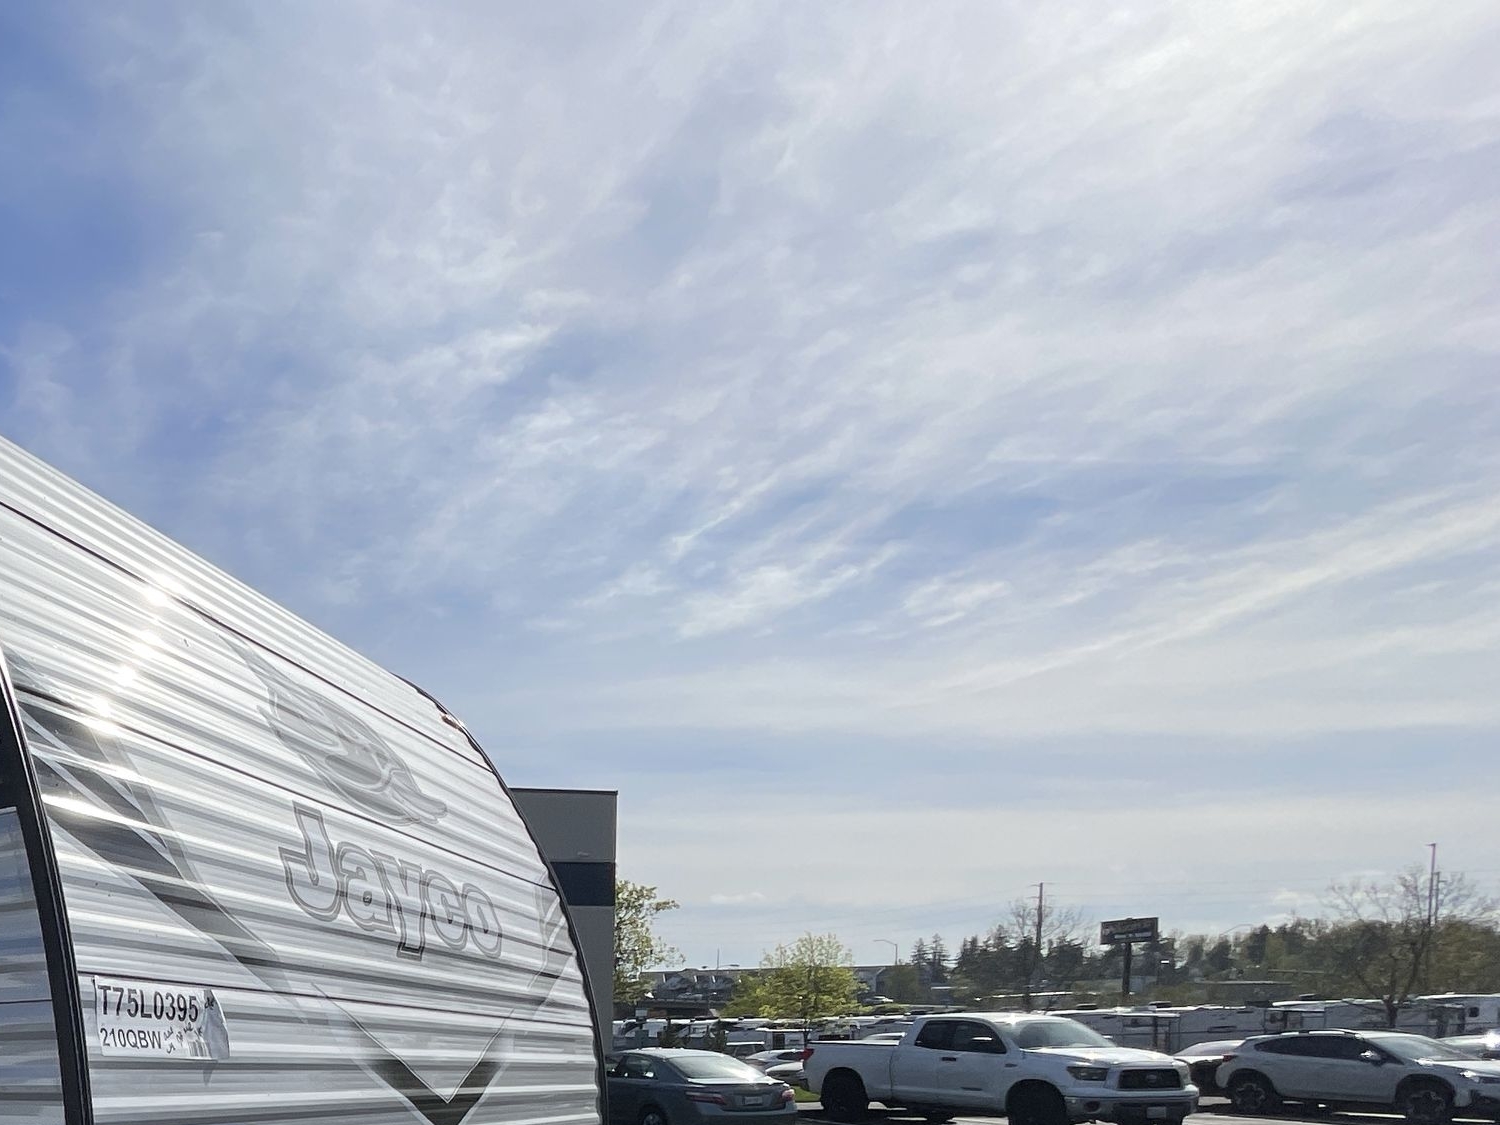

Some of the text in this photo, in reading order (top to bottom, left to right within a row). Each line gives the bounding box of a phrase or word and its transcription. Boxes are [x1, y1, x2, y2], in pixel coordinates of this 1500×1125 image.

[278, 800, 502, 962] Jayco
[98, 985, 199, 1022] T75L0395
[100, 1027, 162, 1049] 210QBW
